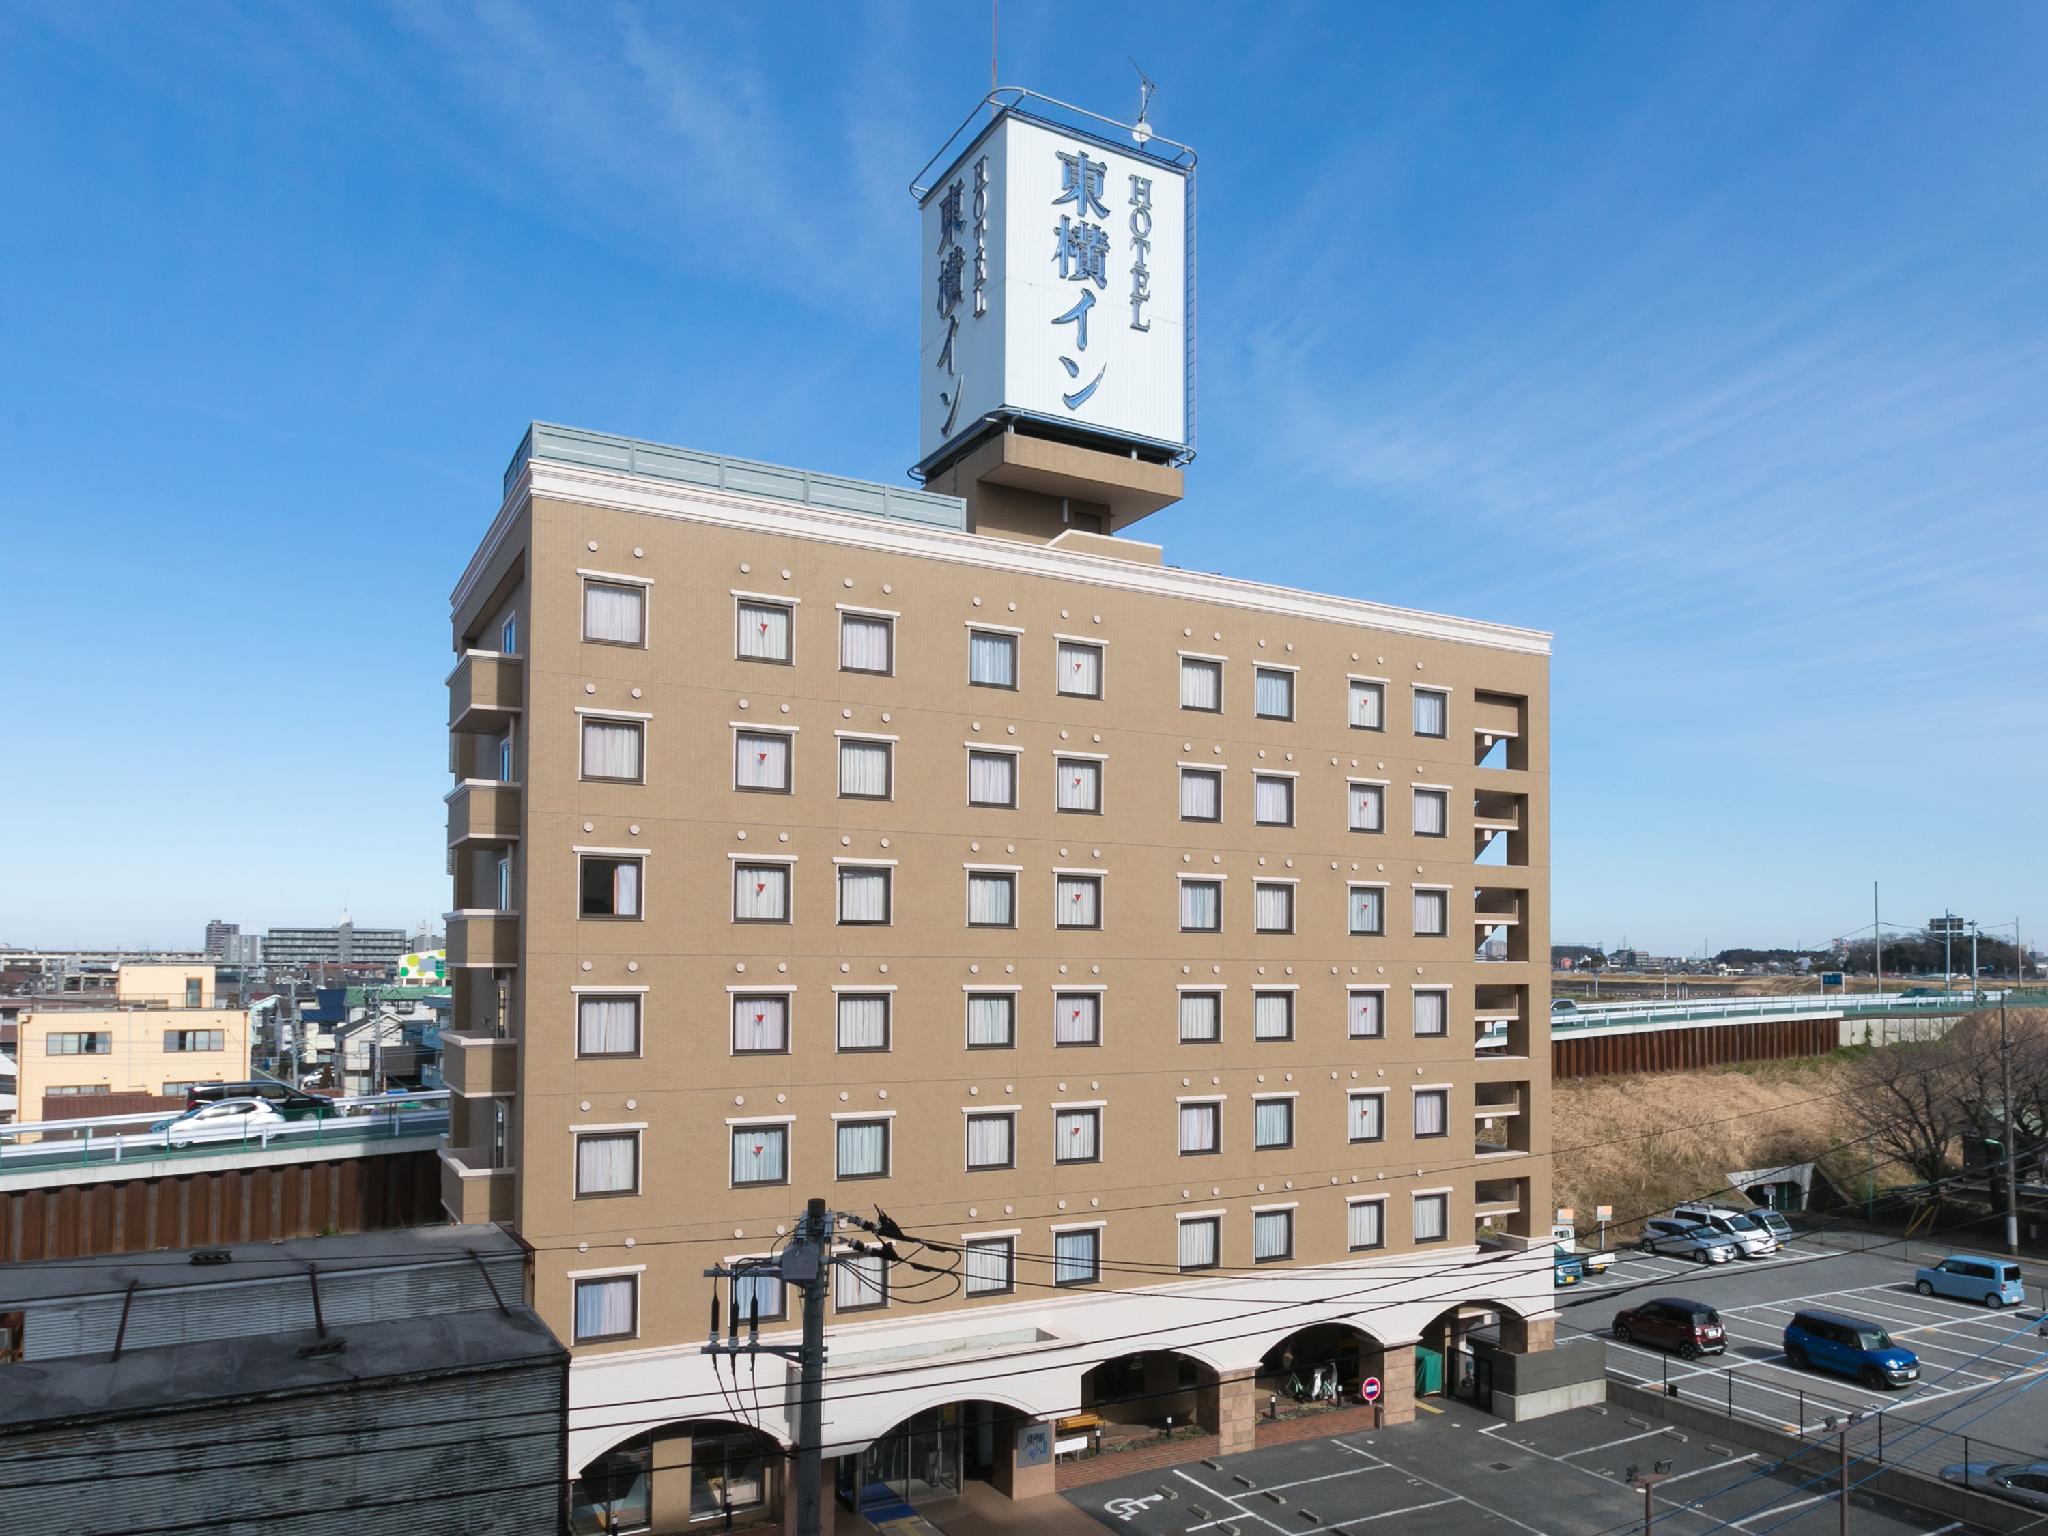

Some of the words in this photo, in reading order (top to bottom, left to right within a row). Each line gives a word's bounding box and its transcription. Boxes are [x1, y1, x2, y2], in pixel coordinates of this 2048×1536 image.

[972, 154, 989, 319] HOTEL
[1051, 150, 1111, 410] 東横イン
[1129, 174, 1152, 332] HOTEL
